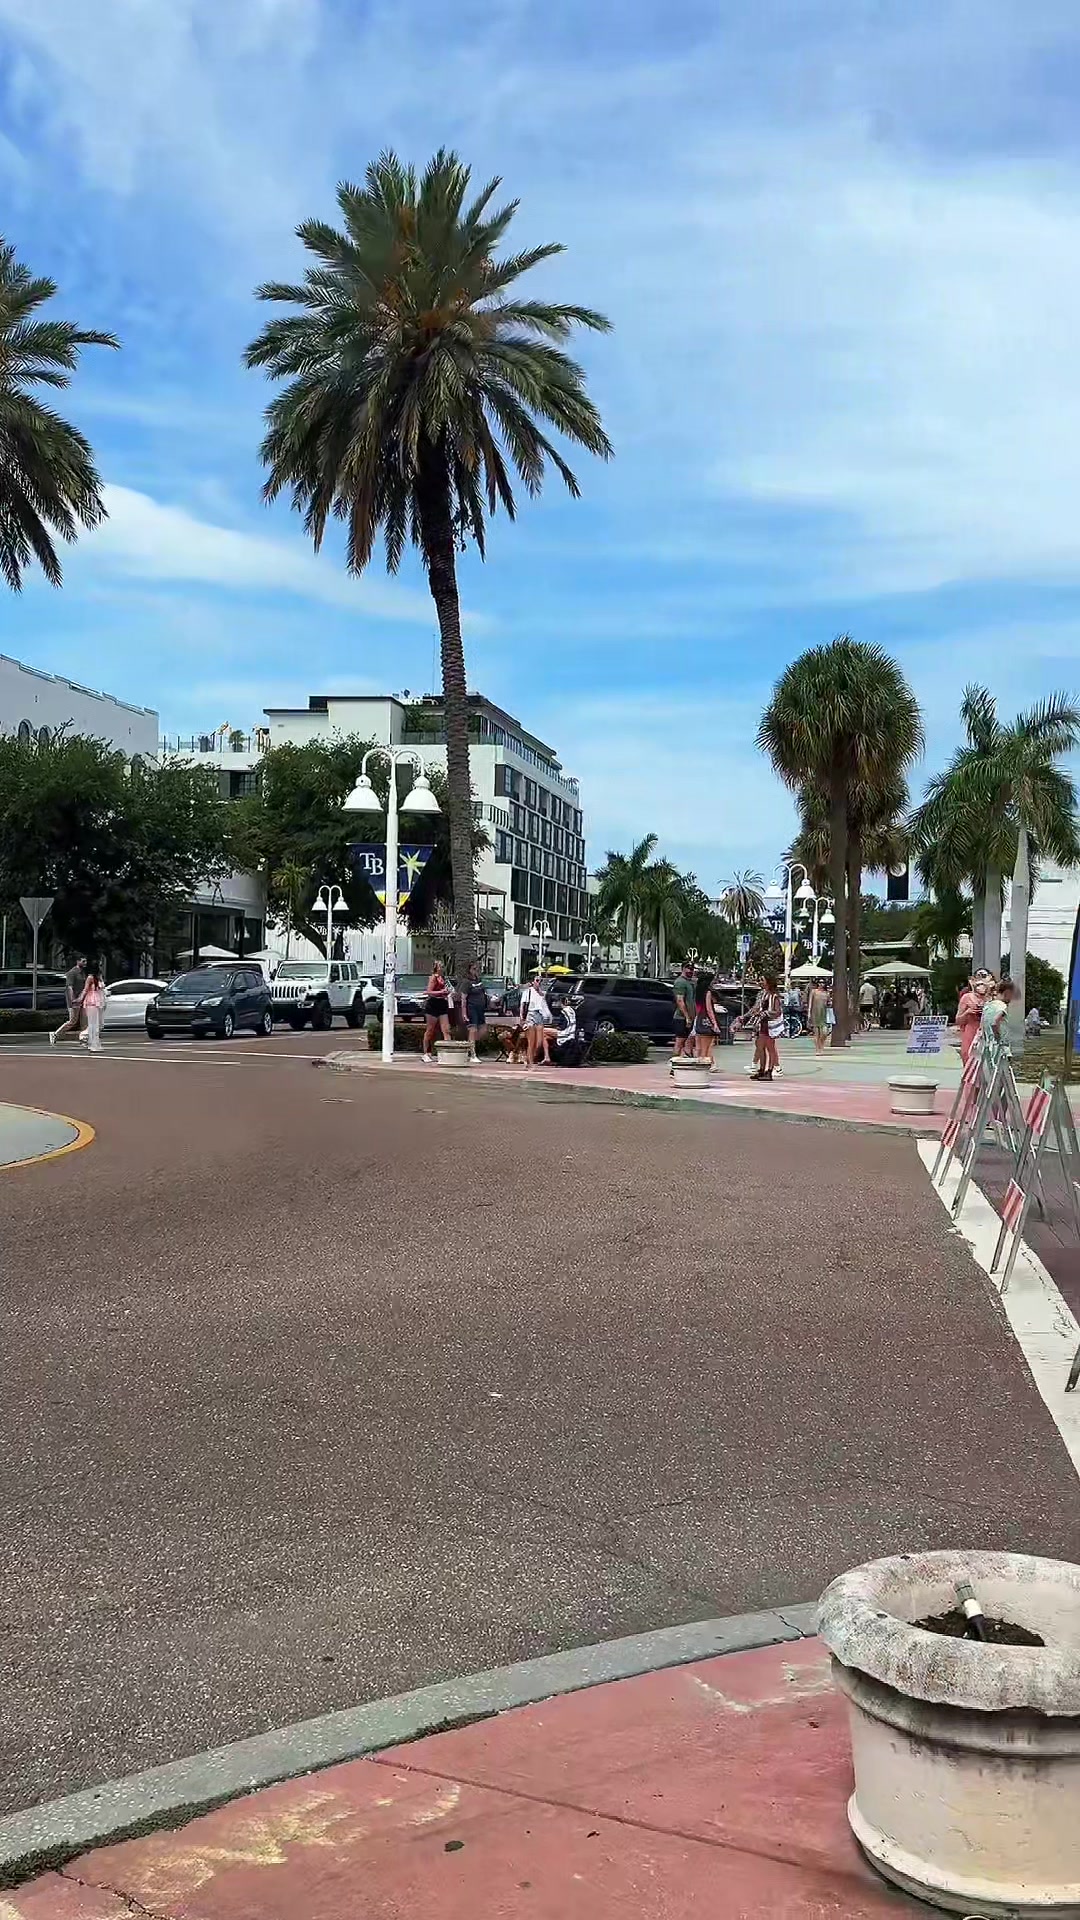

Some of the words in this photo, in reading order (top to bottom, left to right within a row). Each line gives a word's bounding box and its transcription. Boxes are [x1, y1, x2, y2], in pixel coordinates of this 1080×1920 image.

[360, 852, 384, 875] TB
[771, 920, 785, 933] TB
[802, 938, 813, 949] TB
